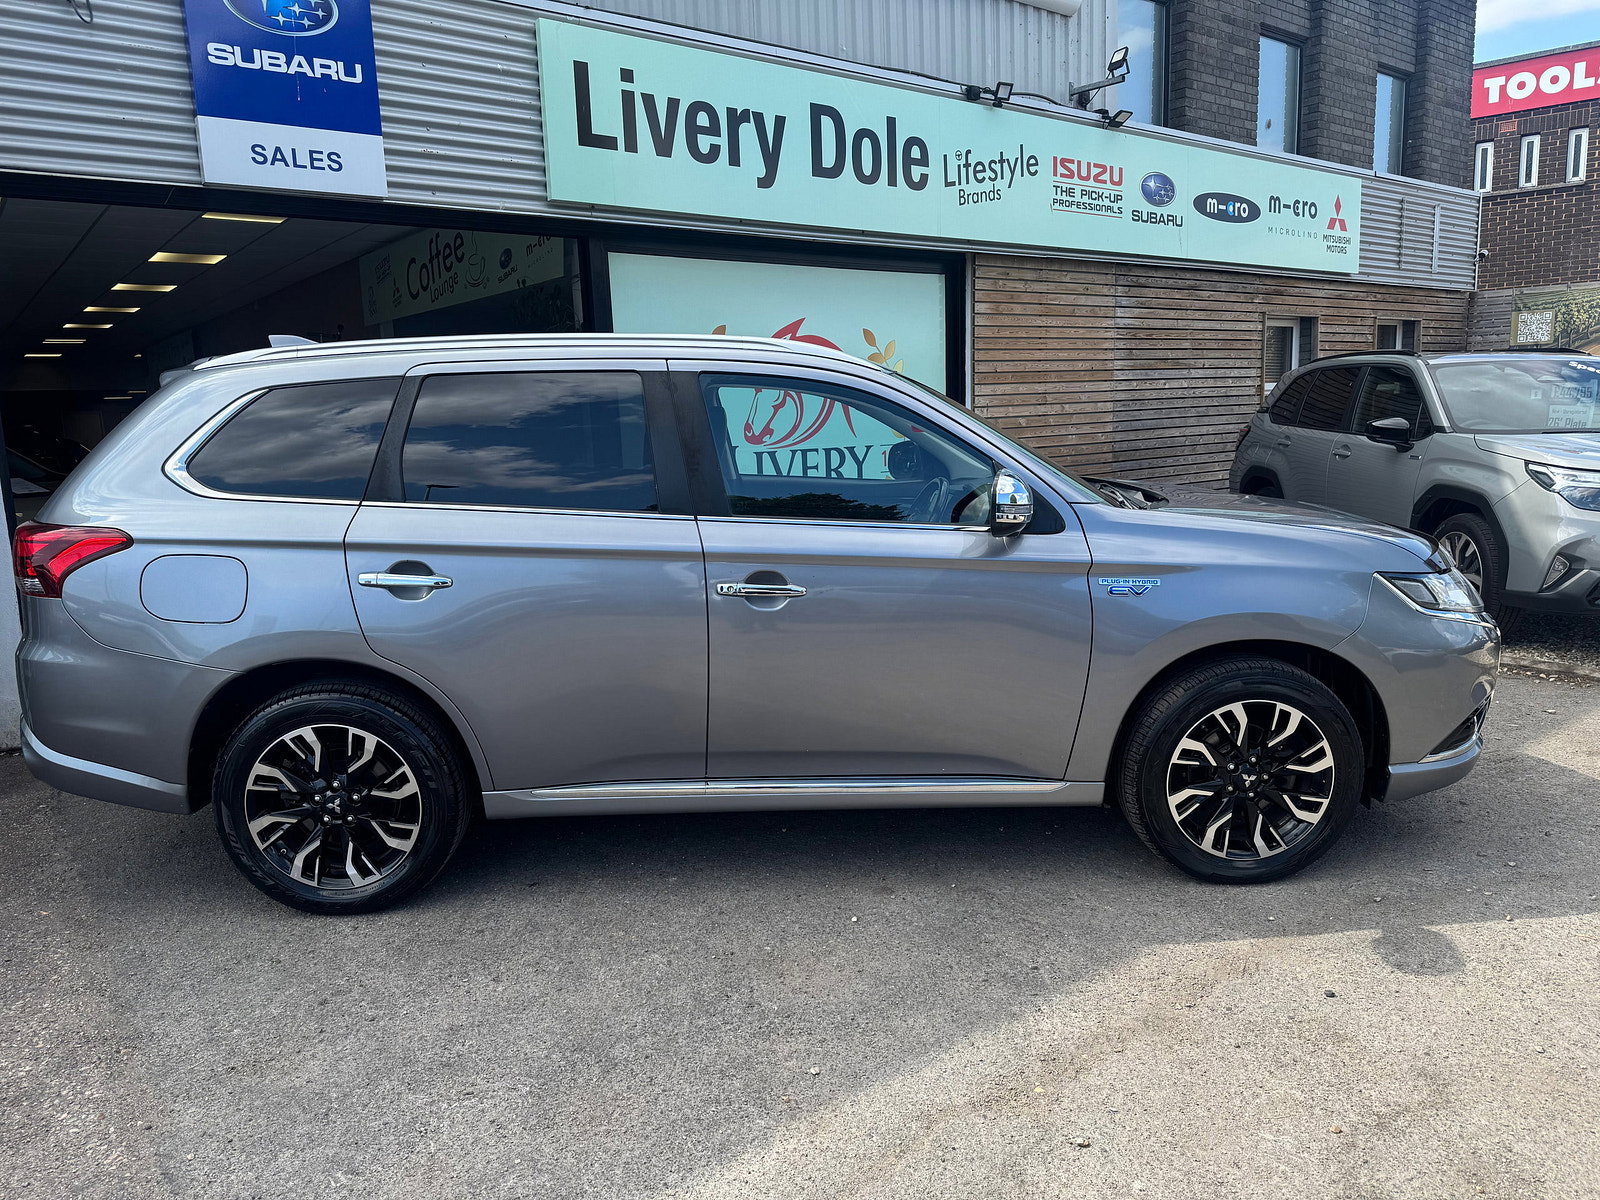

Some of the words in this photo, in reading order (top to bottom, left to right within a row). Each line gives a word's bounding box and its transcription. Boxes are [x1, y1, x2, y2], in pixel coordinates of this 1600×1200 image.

[206, 42, 363, 84] SUBARU
[1484, 60, 1600, 104] TOOL
[573, 59, 787, 189] Livery
[809, 102, 930, 192] Dole
[250, 143, 343, 173] SALES
[943, 143, 1039, 189] Lifestyle
[1052, 155, 1124, 187] ISUZU
[958, 183, 1002, 206] Brands
[1052, 184, 1076, 199] THE
[1080, 188, 1123, 205] PICK-UP
[1052, 198, 1123, 215] PROFESSIONALS
[1131, 209, 1183, 228] SUBARU
[1267, 226, 1319, 240] MICROLINO
[1322, 233, 1352, 246] MITSUBISHI
[1326, 244, 1348, 255] MOTORS
[407, 231, 465, 300] Coffee
[497, 264, 519, 285] SUBARU
[429, 271, 460, 304] Lounge
